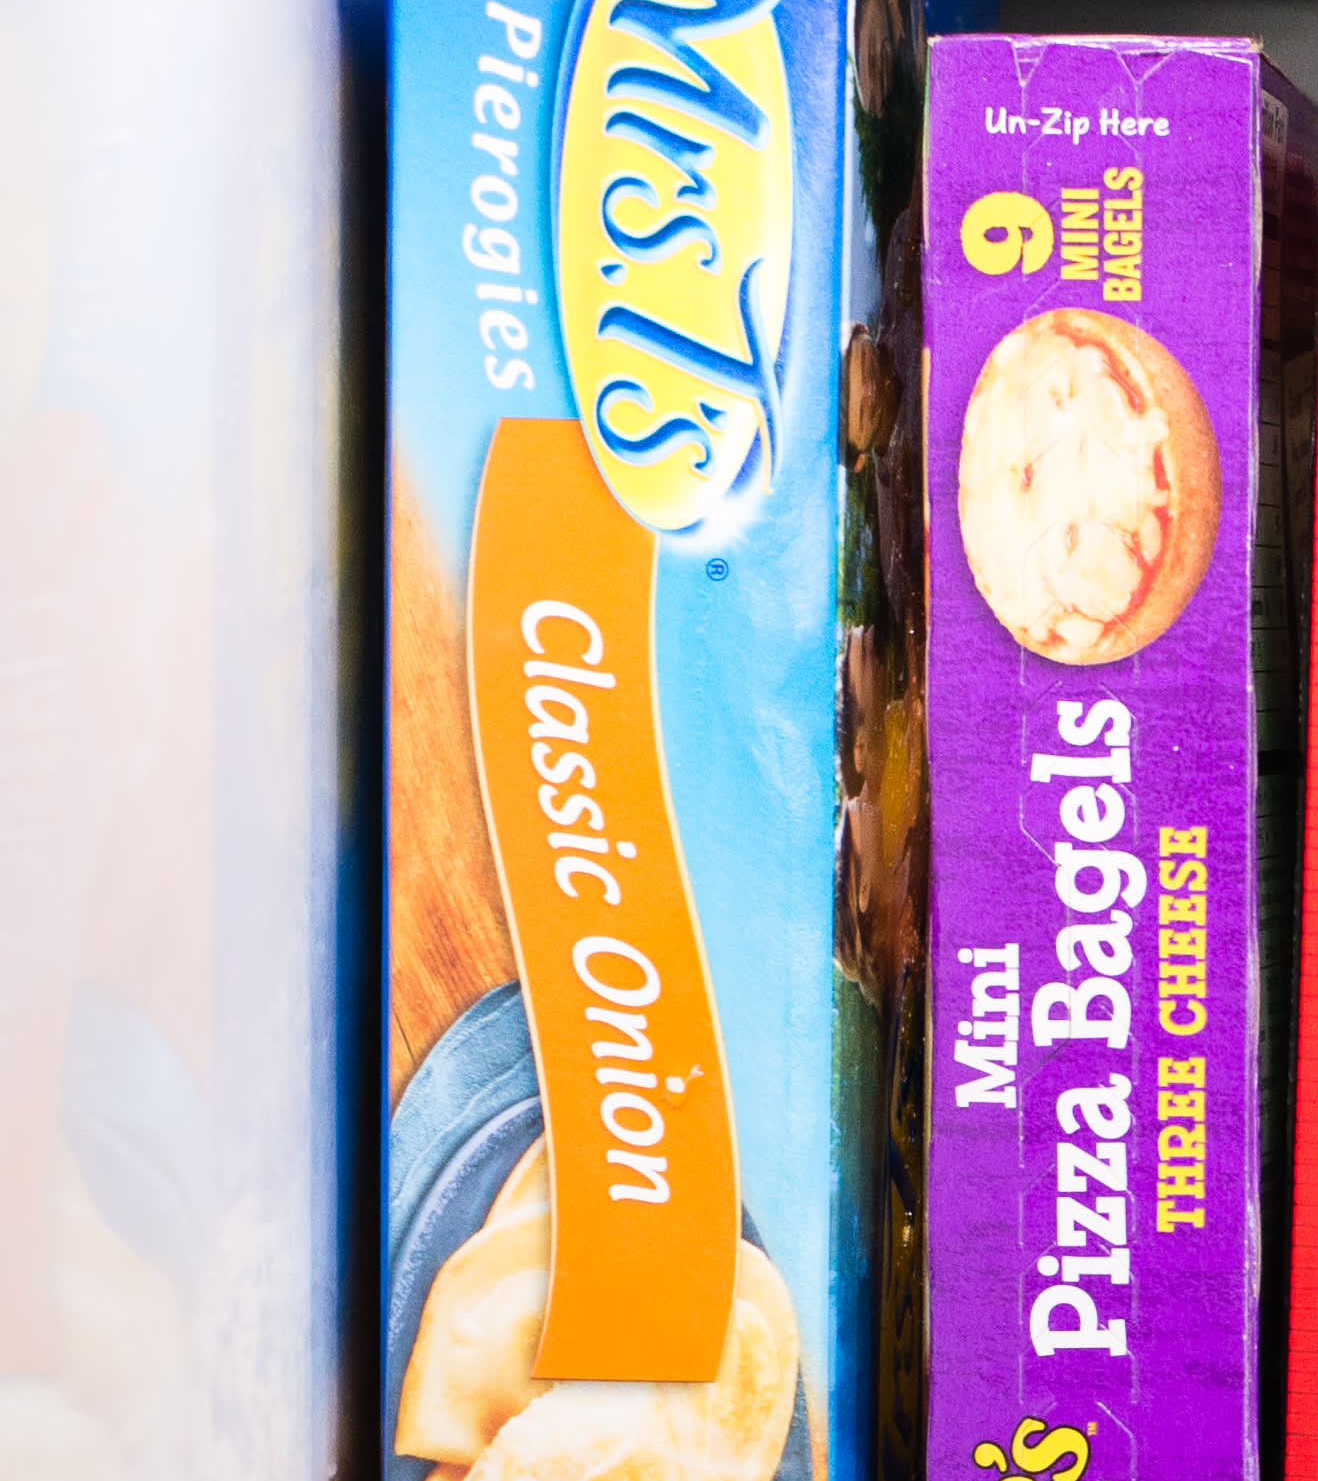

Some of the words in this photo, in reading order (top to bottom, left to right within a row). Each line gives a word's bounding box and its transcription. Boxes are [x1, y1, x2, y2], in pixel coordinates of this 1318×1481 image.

[462, 0, 542, 391] Pierogies
[985, 107, 1090, 144] Un-Zip
[1099, 108, 1170, 137] Here
[961, 191, 1054, 275] 9
[1060, 187, 1100, 281] MINI
[1102, 166, 1144, 302] BAGELS
[520, 598, 638, 907] Classic
[1029, 698, 1148, 1049] Bagels
[1158, 826, 1208, 1036] CHEESE
[571, 935, 687, 1205] Onion
[954, 942, 1020, 1109] Mini
[1028, 1072, 1133, 1357] Pizza
[1156, 1056, 1206, 1233] THREE
